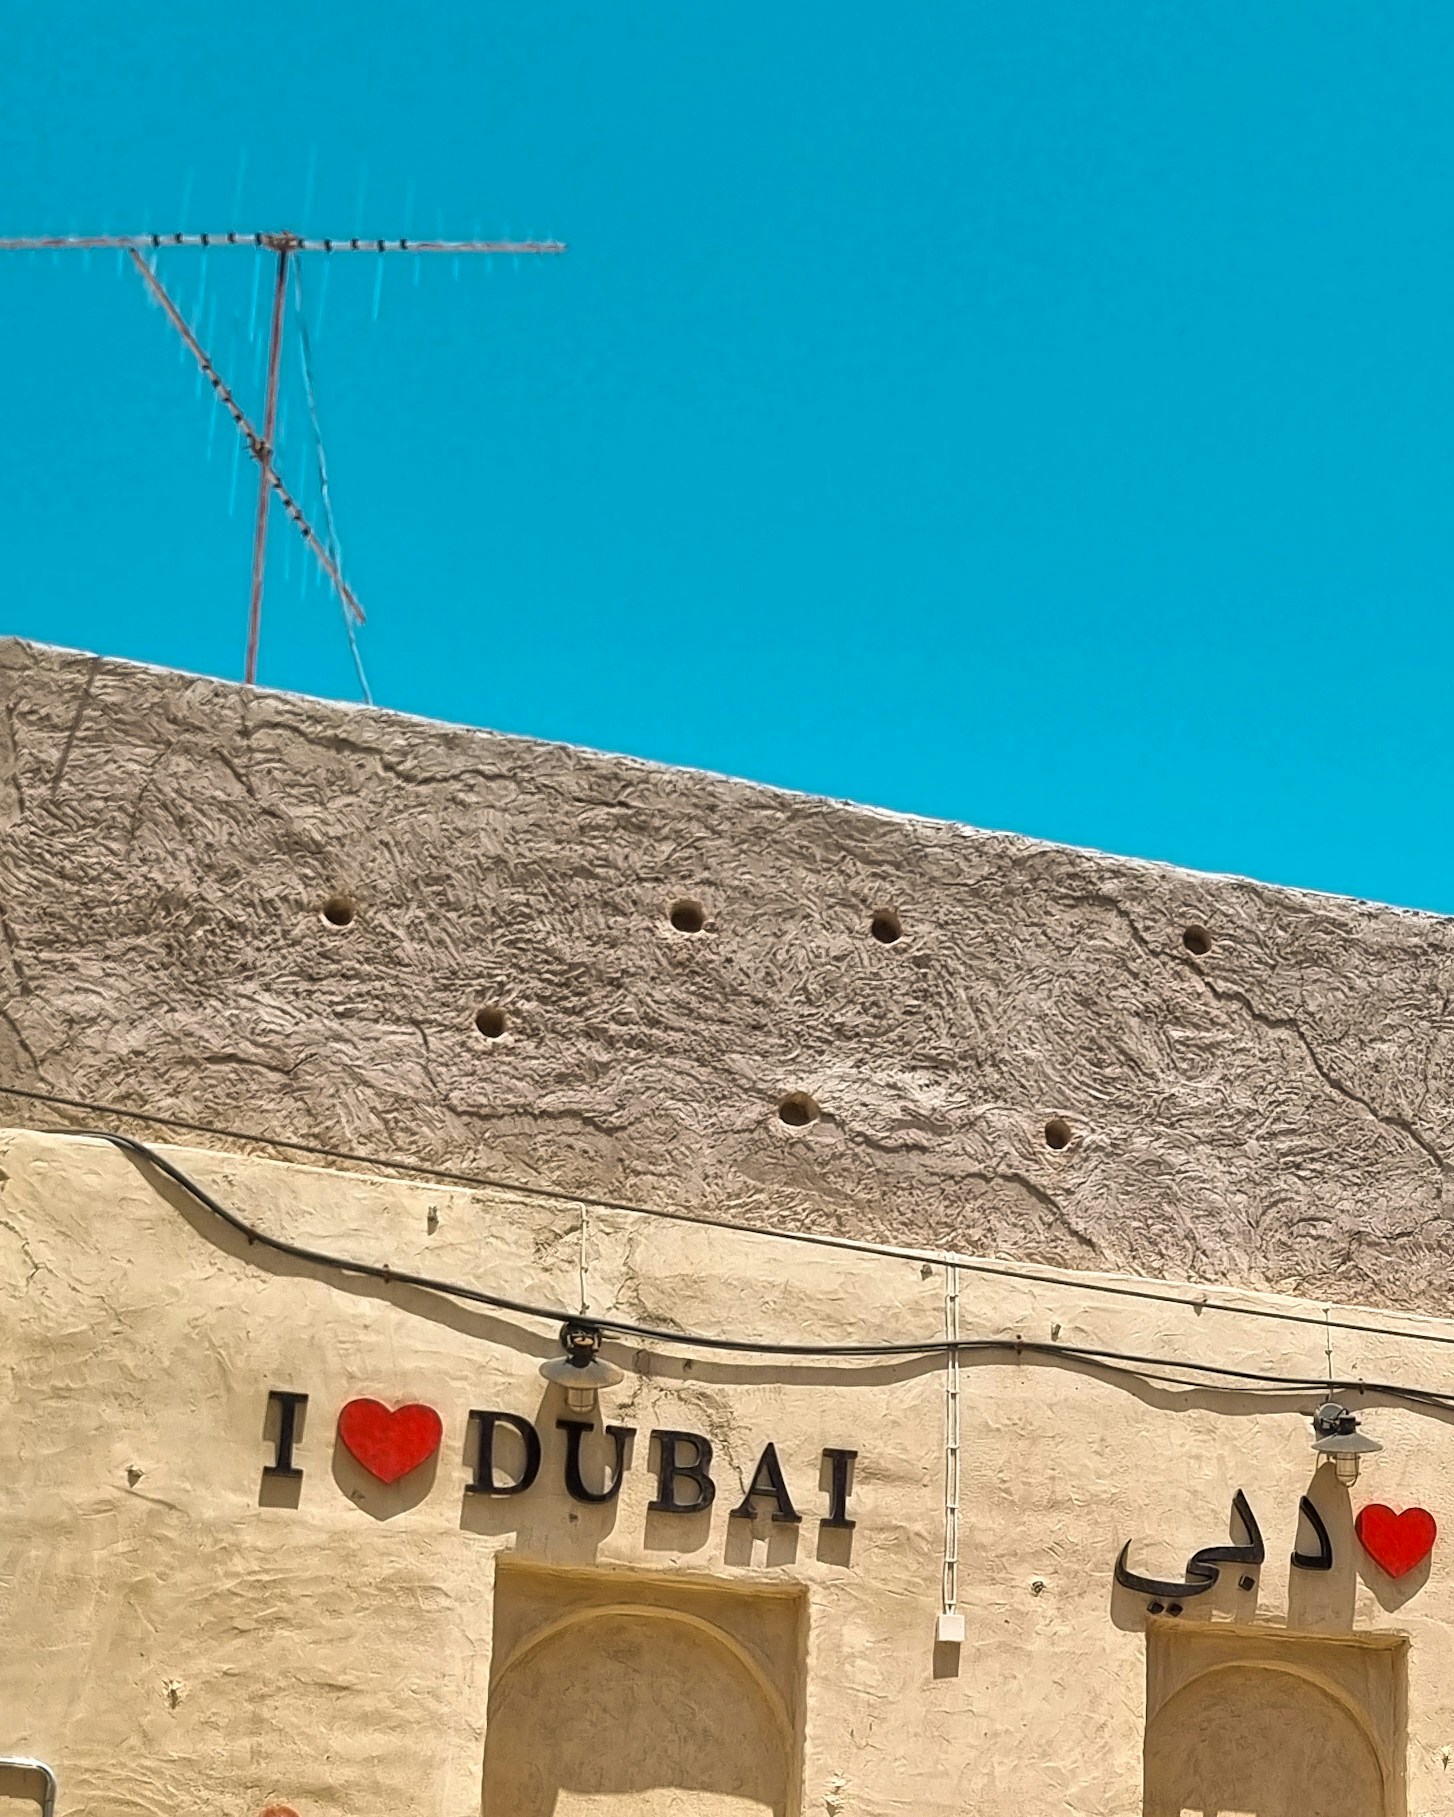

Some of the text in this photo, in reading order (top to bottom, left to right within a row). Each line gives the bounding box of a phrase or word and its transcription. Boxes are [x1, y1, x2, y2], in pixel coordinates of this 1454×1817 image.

[263, 1390, 858, 1529] I DUBAI
[1114, 1488, 1333, 1617] دبي
